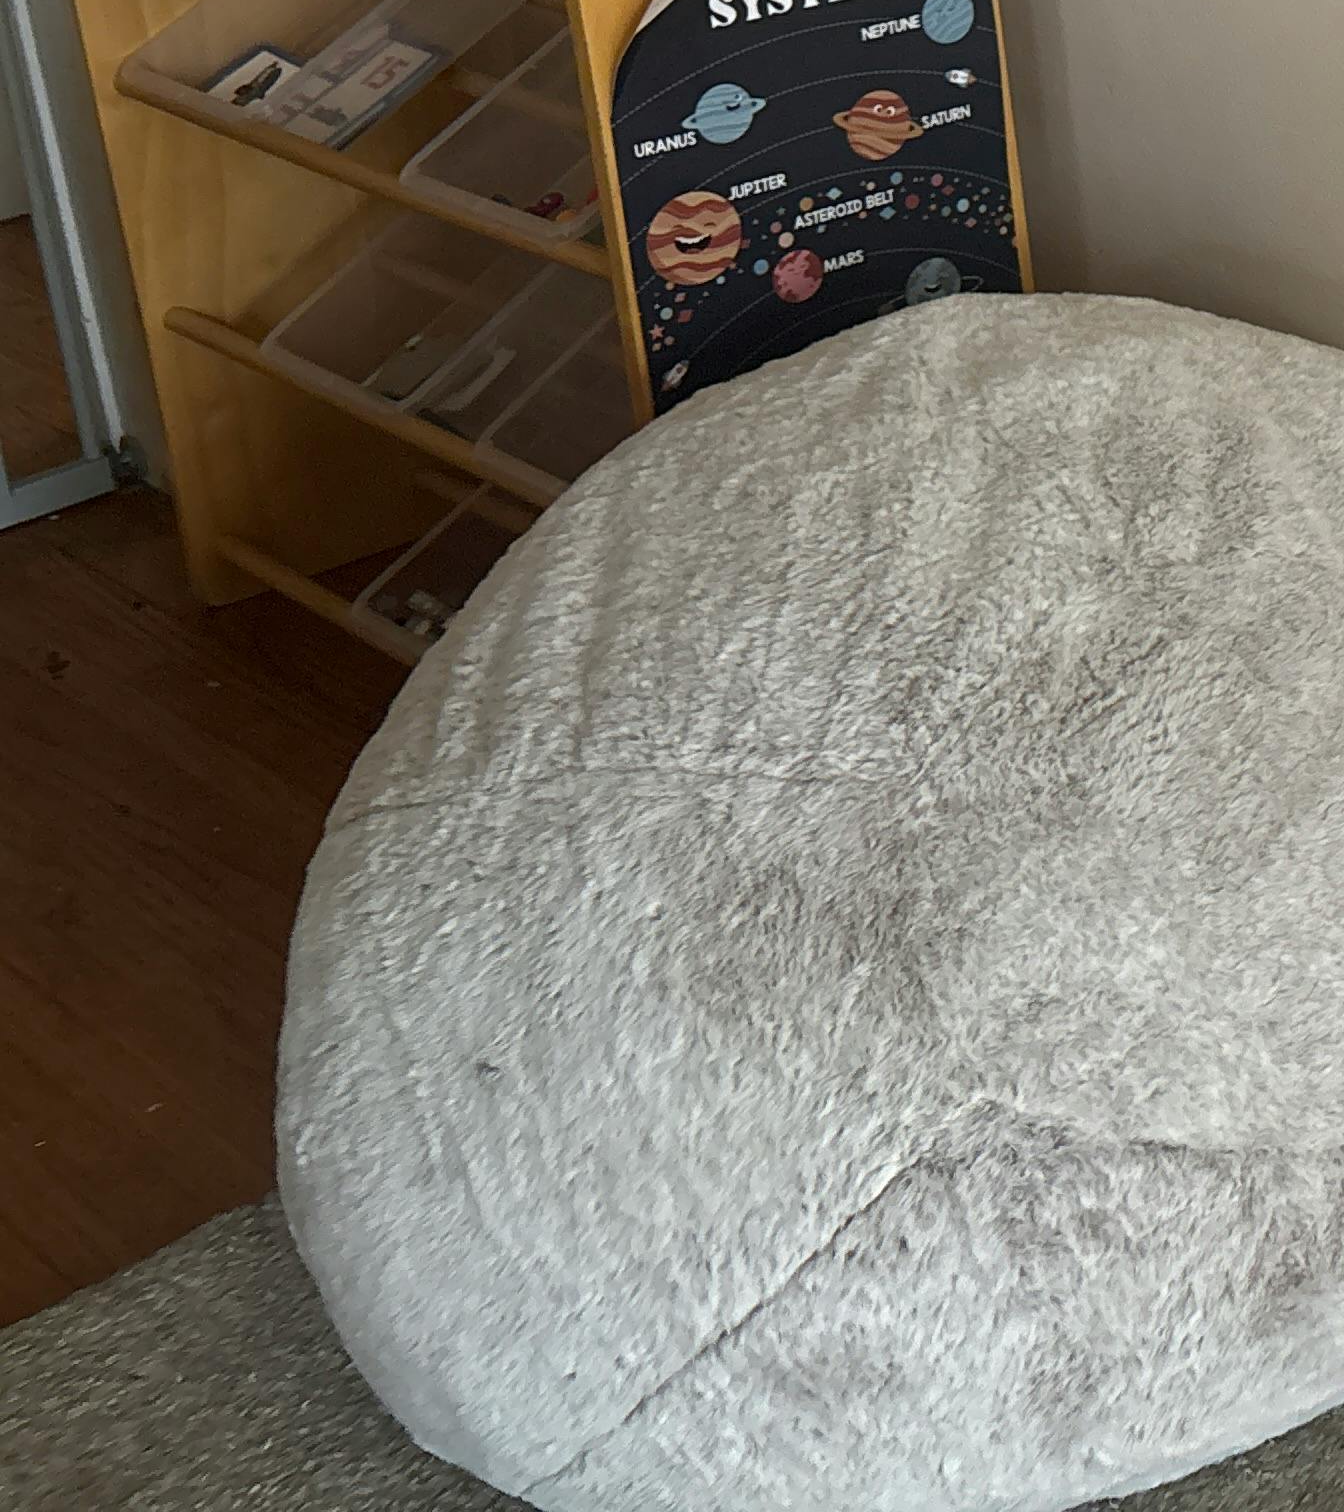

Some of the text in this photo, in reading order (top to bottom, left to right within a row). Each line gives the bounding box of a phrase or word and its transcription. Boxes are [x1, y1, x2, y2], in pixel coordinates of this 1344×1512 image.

[860, 14, 921, 42] NEPTUNE
[921, 105, 971, 131] SATURN
[634, 131, 697, 159] URANUS
[727, 173, 786, 201] JUPITER
[794, 190, 895, 231] ASTEROID BELT
[823, 250, 865, 273] MARS
